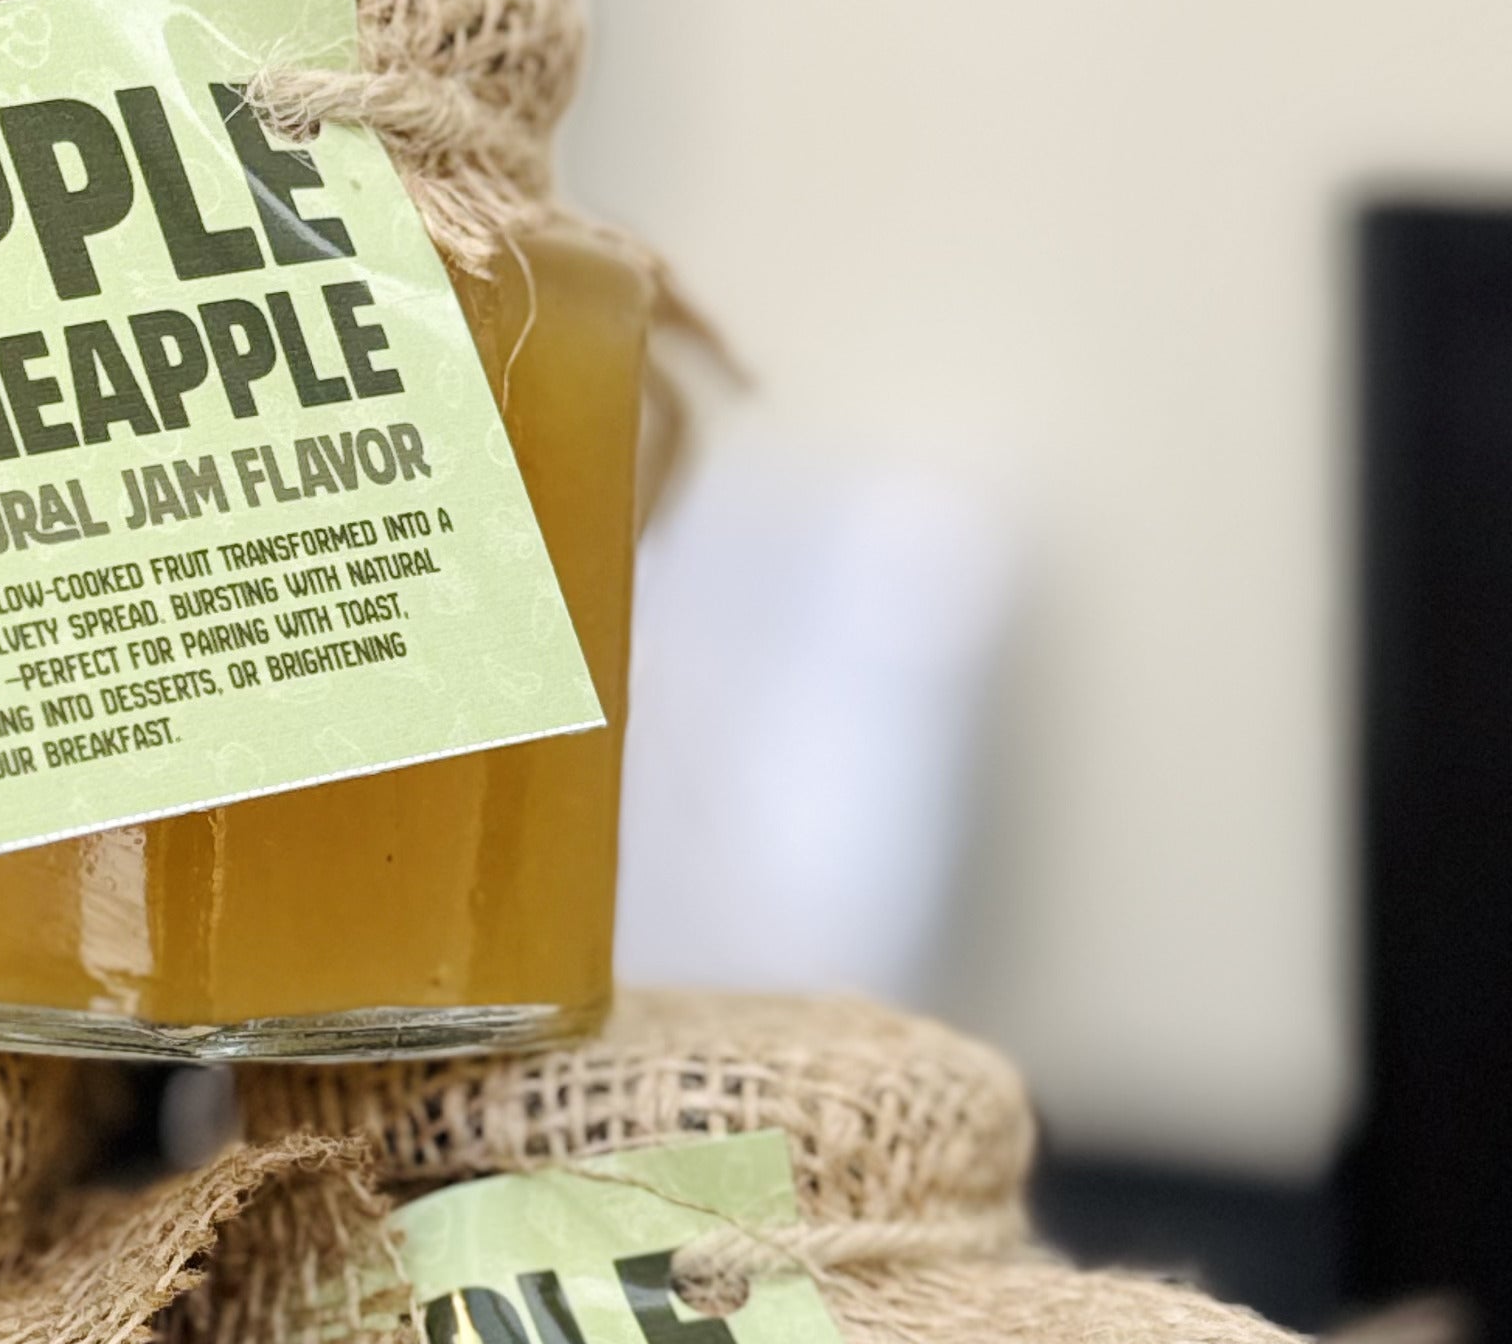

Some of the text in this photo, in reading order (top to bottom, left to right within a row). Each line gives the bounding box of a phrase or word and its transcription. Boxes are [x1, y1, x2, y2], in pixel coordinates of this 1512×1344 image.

[120, 454, 231, 531] JAM
[230, 422, 432, 508] FLAVOR
[149, 548, 213, 585] FRUIT
[216, 519, 378, 572] TRANSFORMED
[382, 510, 432, 542] INTO
[437, 506, 454, 533] A
[169, 576, 280, 621] BURSTING
[282, 564, 342, 599] WITH
[345, 547, 441, 588] NATURAL
[126, 635, 176, 670] FOR
[179, 617, 271, 659] PAIRING
[273, 605, 334, 640] WITH
[335, 591, 409, 629] TOAST,
[40, 693, 95, 728] INTO
[99, 668, 224, 716] DESSERTS,
[227, 659, 261, 690] OR
[265, 631, 407, 682] BRIGHTENING
[42, 716, 181, 769] BREAKFAST.
